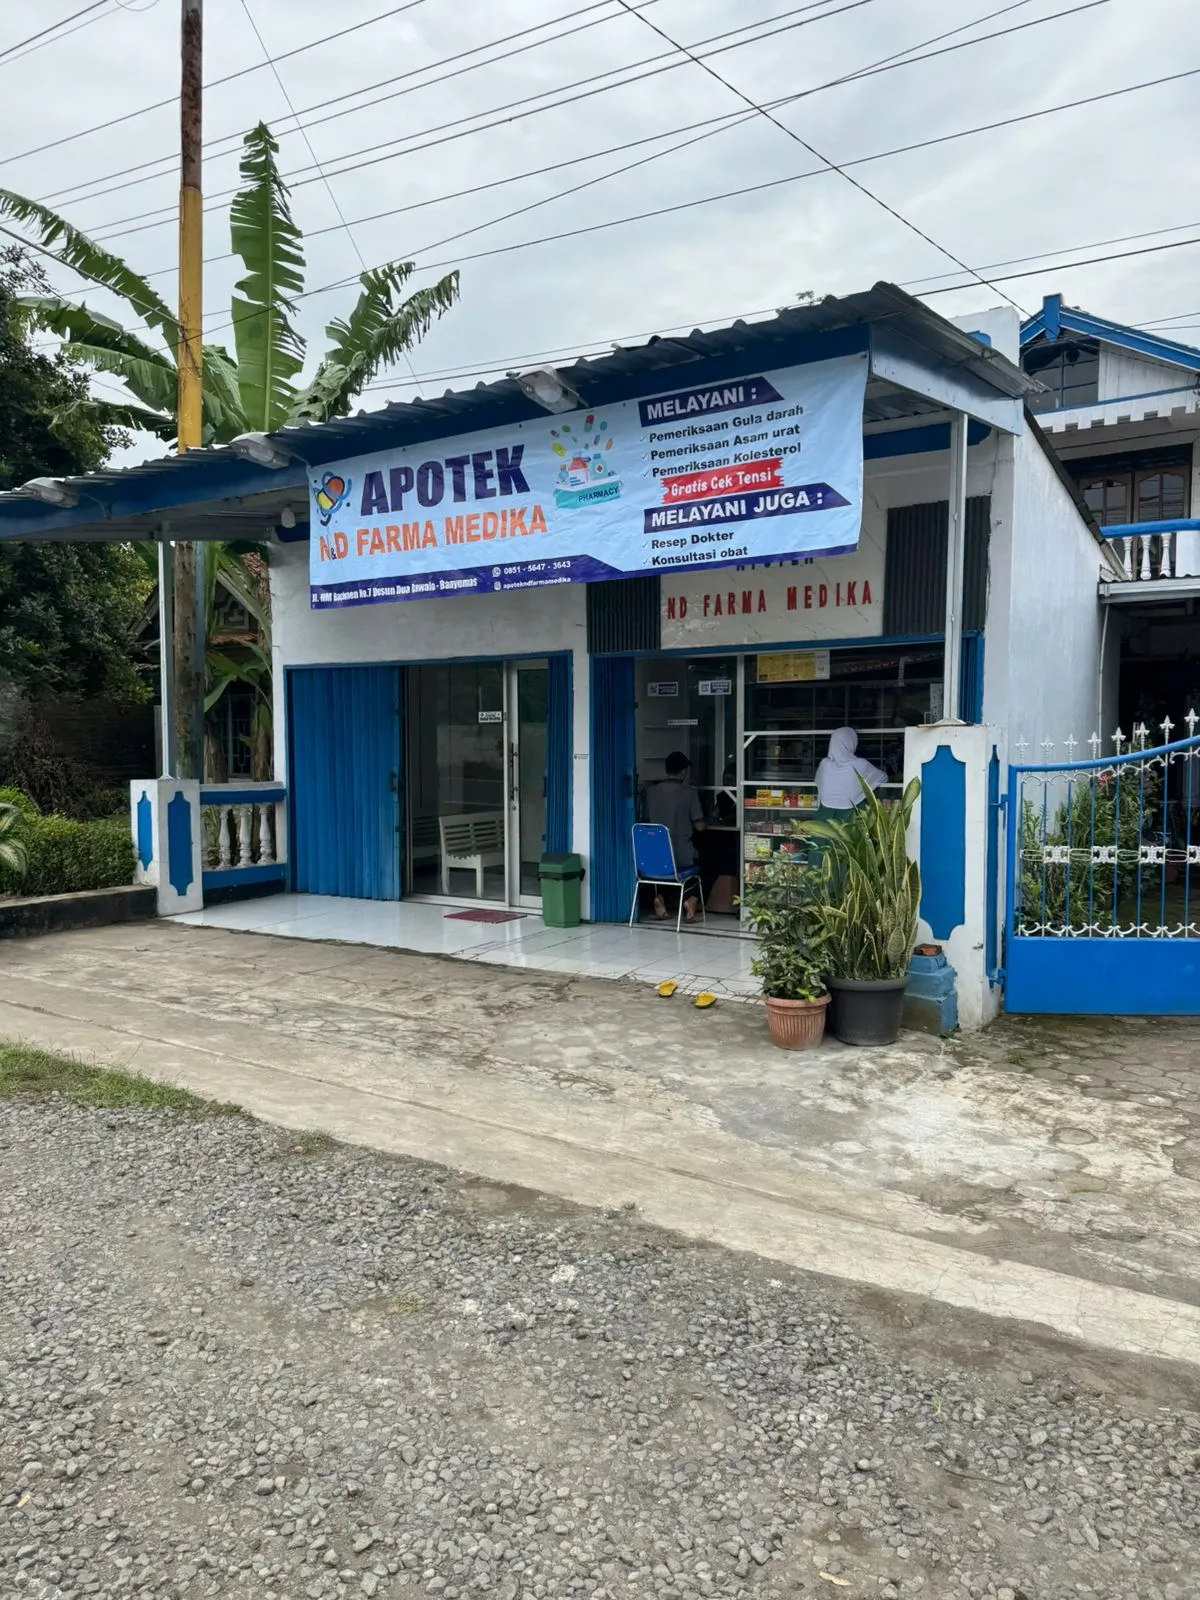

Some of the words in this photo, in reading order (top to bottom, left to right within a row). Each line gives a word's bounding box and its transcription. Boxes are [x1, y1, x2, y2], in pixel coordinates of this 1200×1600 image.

[647, 386, 744, 419] MELAYANI
[650, 422, 728, 442] Pemeriksaan
[732, 414, 762, 427] Gula
[766, 405, 803, 422] darah
[651, 440, 729, 460] Pemeriksaan
[734, 432, 768, 446] Asam
[772, 424, 800, 438] urat
[652, 457, 730, 477] Pemeriksaan
[733, 442, 801, 463] Kolesterol
[360, 444, 531, 516] APOTEK
[578, 486, 618, 502] PHARMACY
[671, 481, 708, 497] Gratis
[710, 476, 732, 490] Cek
[736, 468, 772, 485] Tensi
[652, 500, 746, 527] MELAYANI
[754, 491, 810, 513] JUGA
[320, 532, 348, 562] N&D
[356, 520, 437, 556] FARMA
[444, 504, 548, 546] MEDIKA
[652, 537, 687, 549] Resep
[692, 531, 734, 544] Dokter
[504, 566, 521, 574] 0851
[528, 563, 546, 572] 5647
[553, 560, 571, 570] 3643
[652, 551, 716, 566] Konsultasi
[720, 546, 748, 558] obat
[440, 578, 478, 590] Banyumas
[667, 596, 688, 620] ND
[704, 589, 766, 617] FARMA
[787, 580, 872, 610] MEDIKA
